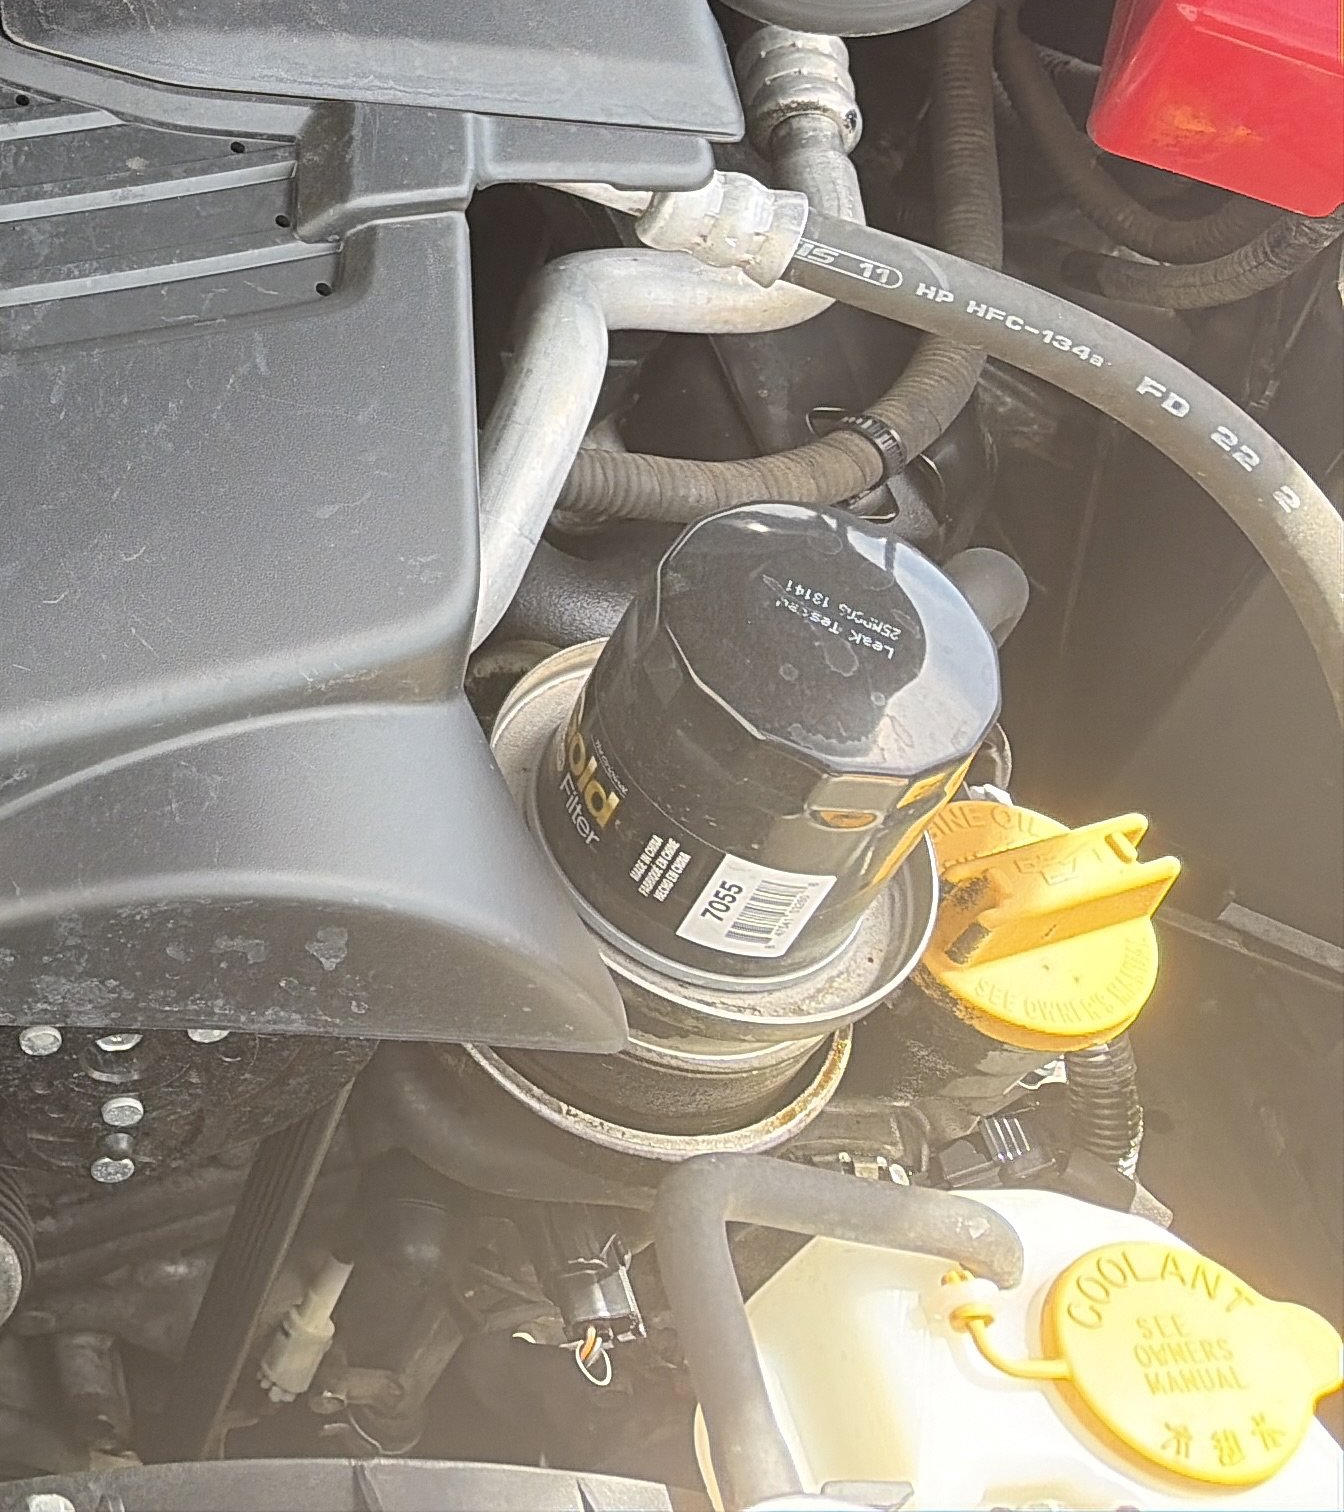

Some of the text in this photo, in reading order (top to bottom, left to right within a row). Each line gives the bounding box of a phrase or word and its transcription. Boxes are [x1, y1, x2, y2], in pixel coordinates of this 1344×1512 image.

[915, 282, 954, 304] HP
[965, 299, 1105, 368] HFC-134a
[1135, 375, 1191, 418] FD
[1210, 425, 1261, 473] 22
[785, 579, 830, 608] 13141
[847, 629, 895, 660] Leak
[568, 722, 620, 829] old
[559, 771, 601, 845] Filter
[990, 807, 1041, 838] OIL
[629, 834, 664, 882] MADE IN CHINA
[655, 855, 669, 870] EN
[670, 851, 692, 874] CHINA
[665, 868, 680, 883] EN
[700, 879, 744, 922] 7055
[1066, 1248, 1257, 1331] COOLANT
[1135, 1313, 1192, 1341] SEE
[1143, 1366, 1250, 1396] MANUAL
